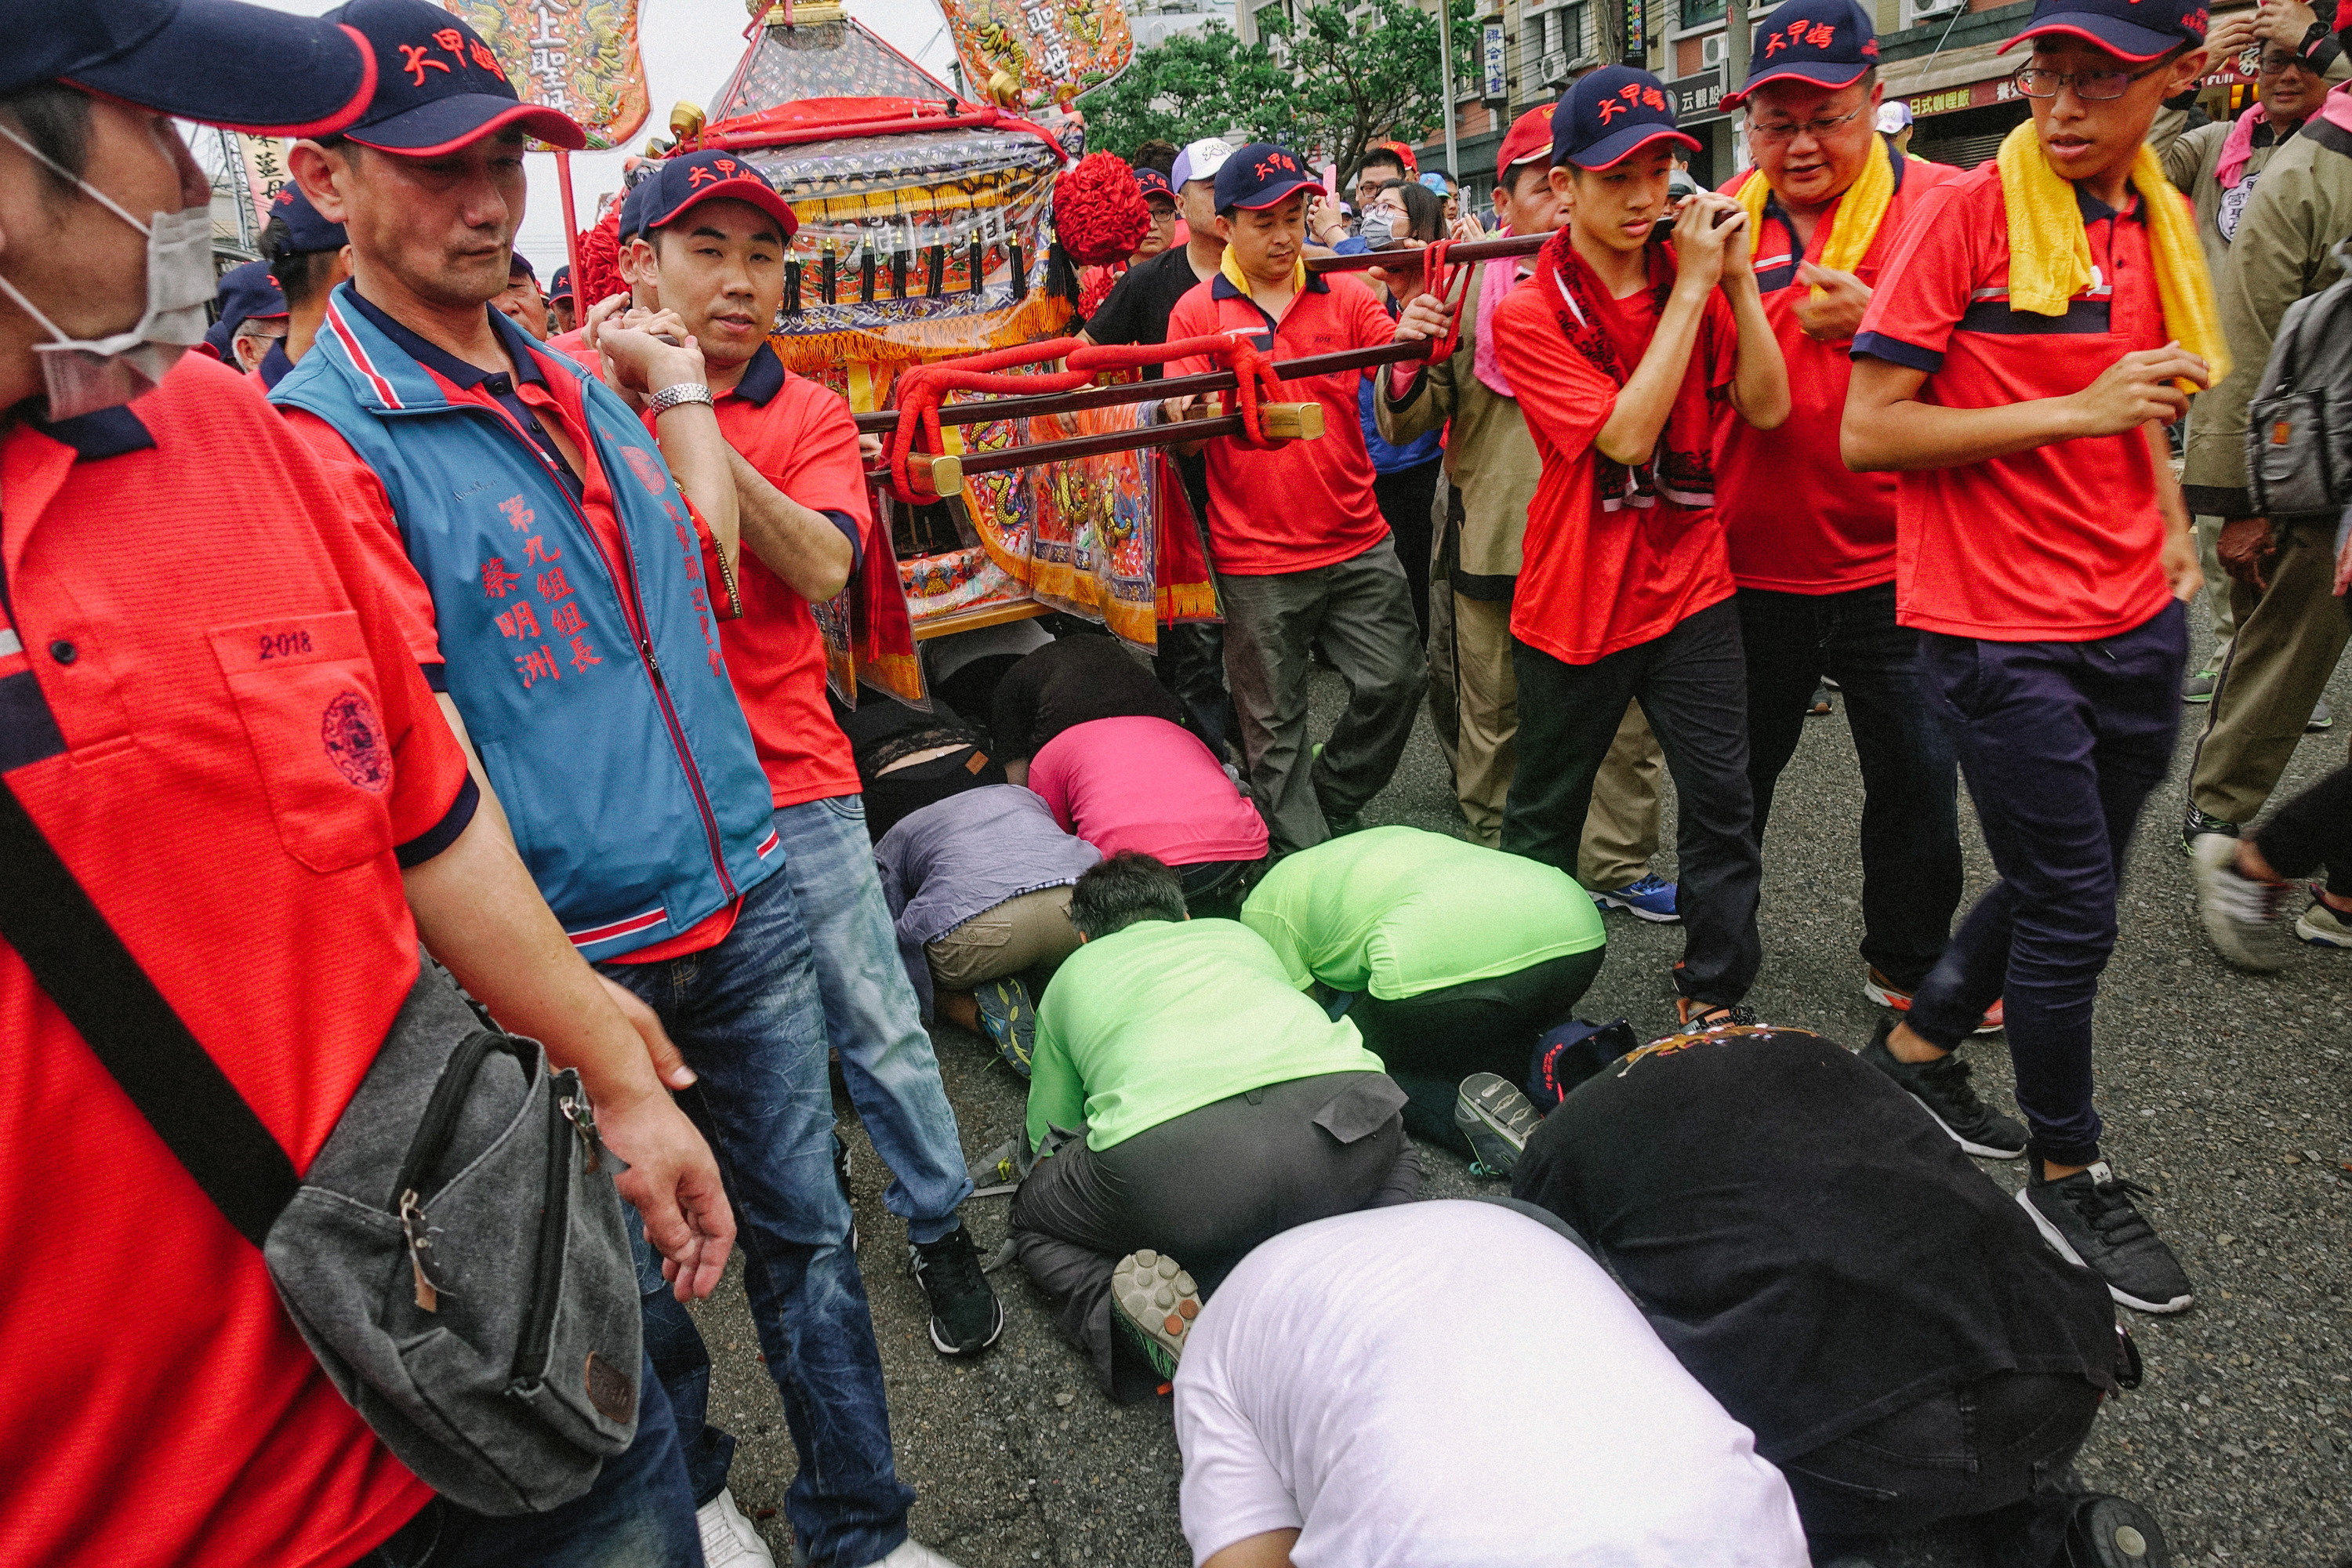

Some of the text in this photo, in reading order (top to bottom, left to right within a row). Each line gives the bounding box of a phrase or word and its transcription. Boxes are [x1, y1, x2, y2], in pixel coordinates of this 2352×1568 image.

[398, 28, 506, 87] 大甲媽
[1766, 20, 1835, 59] 大甲媽
[1486, 28, 1504, 93] 聯合代書
[1598, 83, 1665, 126] 大甲媽
[1254, 153, 1296, 181] 大甲媽
[260, 630, 312, 660] 2018
